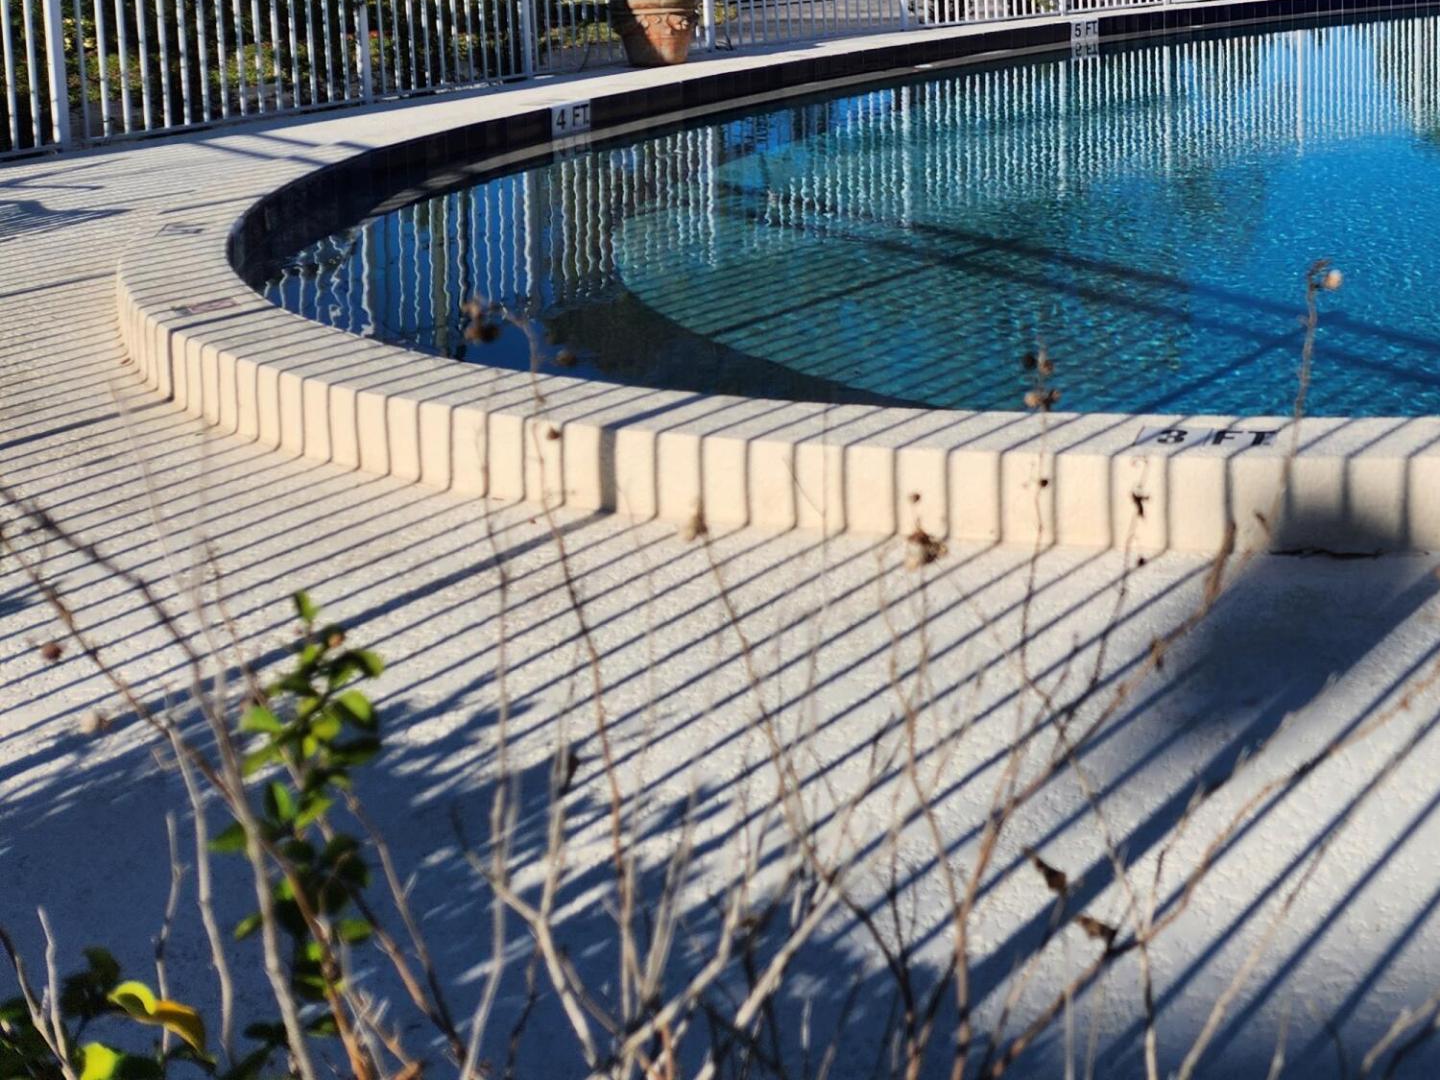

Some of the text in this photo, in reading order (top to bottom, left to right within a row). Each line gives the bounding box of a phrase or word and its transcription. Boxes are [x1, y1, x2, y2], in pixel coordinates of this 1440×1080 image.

[1075, 23, 1082, 37] 5
[556, 109, 566, 130] 4
[1157, 429, 1188, 445] 3
